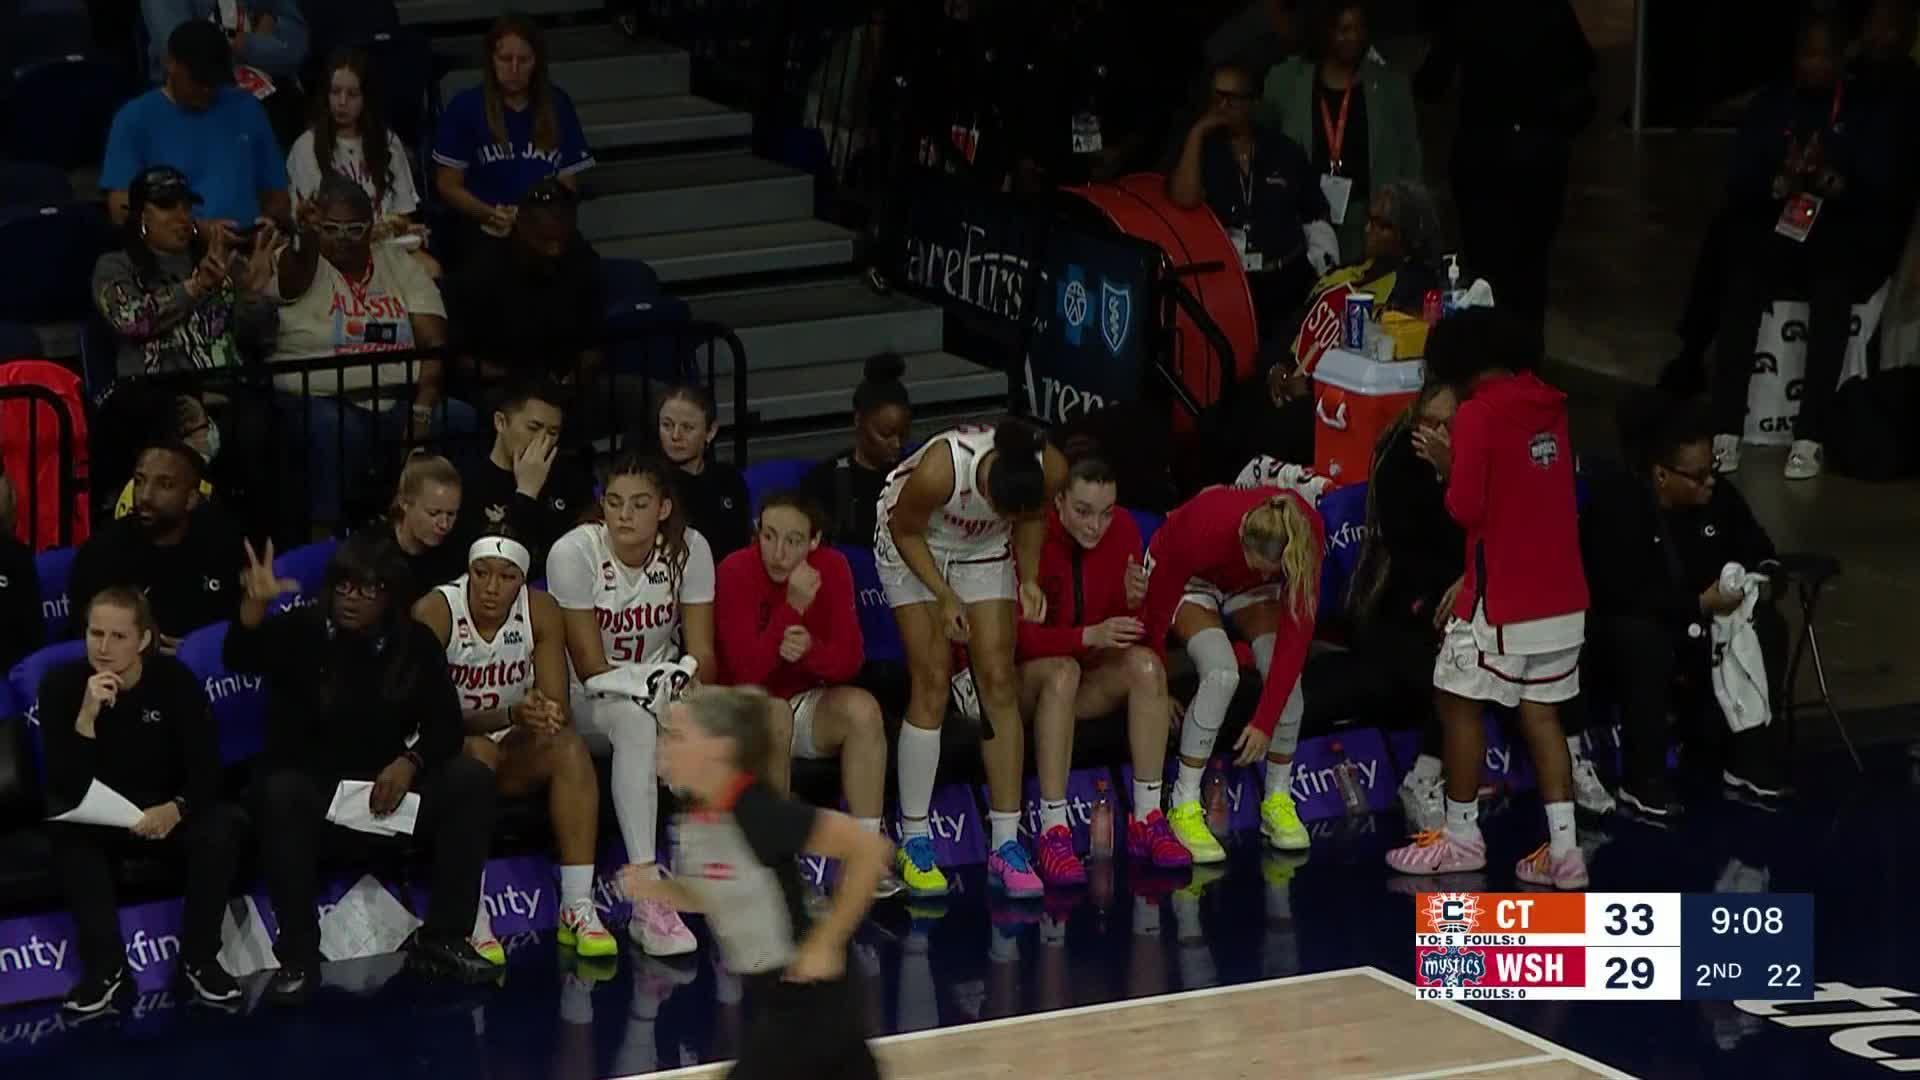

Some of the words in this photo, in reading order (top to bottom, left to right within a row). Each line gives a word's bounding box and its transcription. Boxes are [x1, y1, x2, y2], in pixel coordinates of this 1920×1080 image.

[1022, 352, 1121, 425] Aren
[595, 603, 674, 634] mystics
[613, 636, 645, 663] 51
[448, 661, 525, 689] mystics
[1291, 760, 1378, 802] finy
